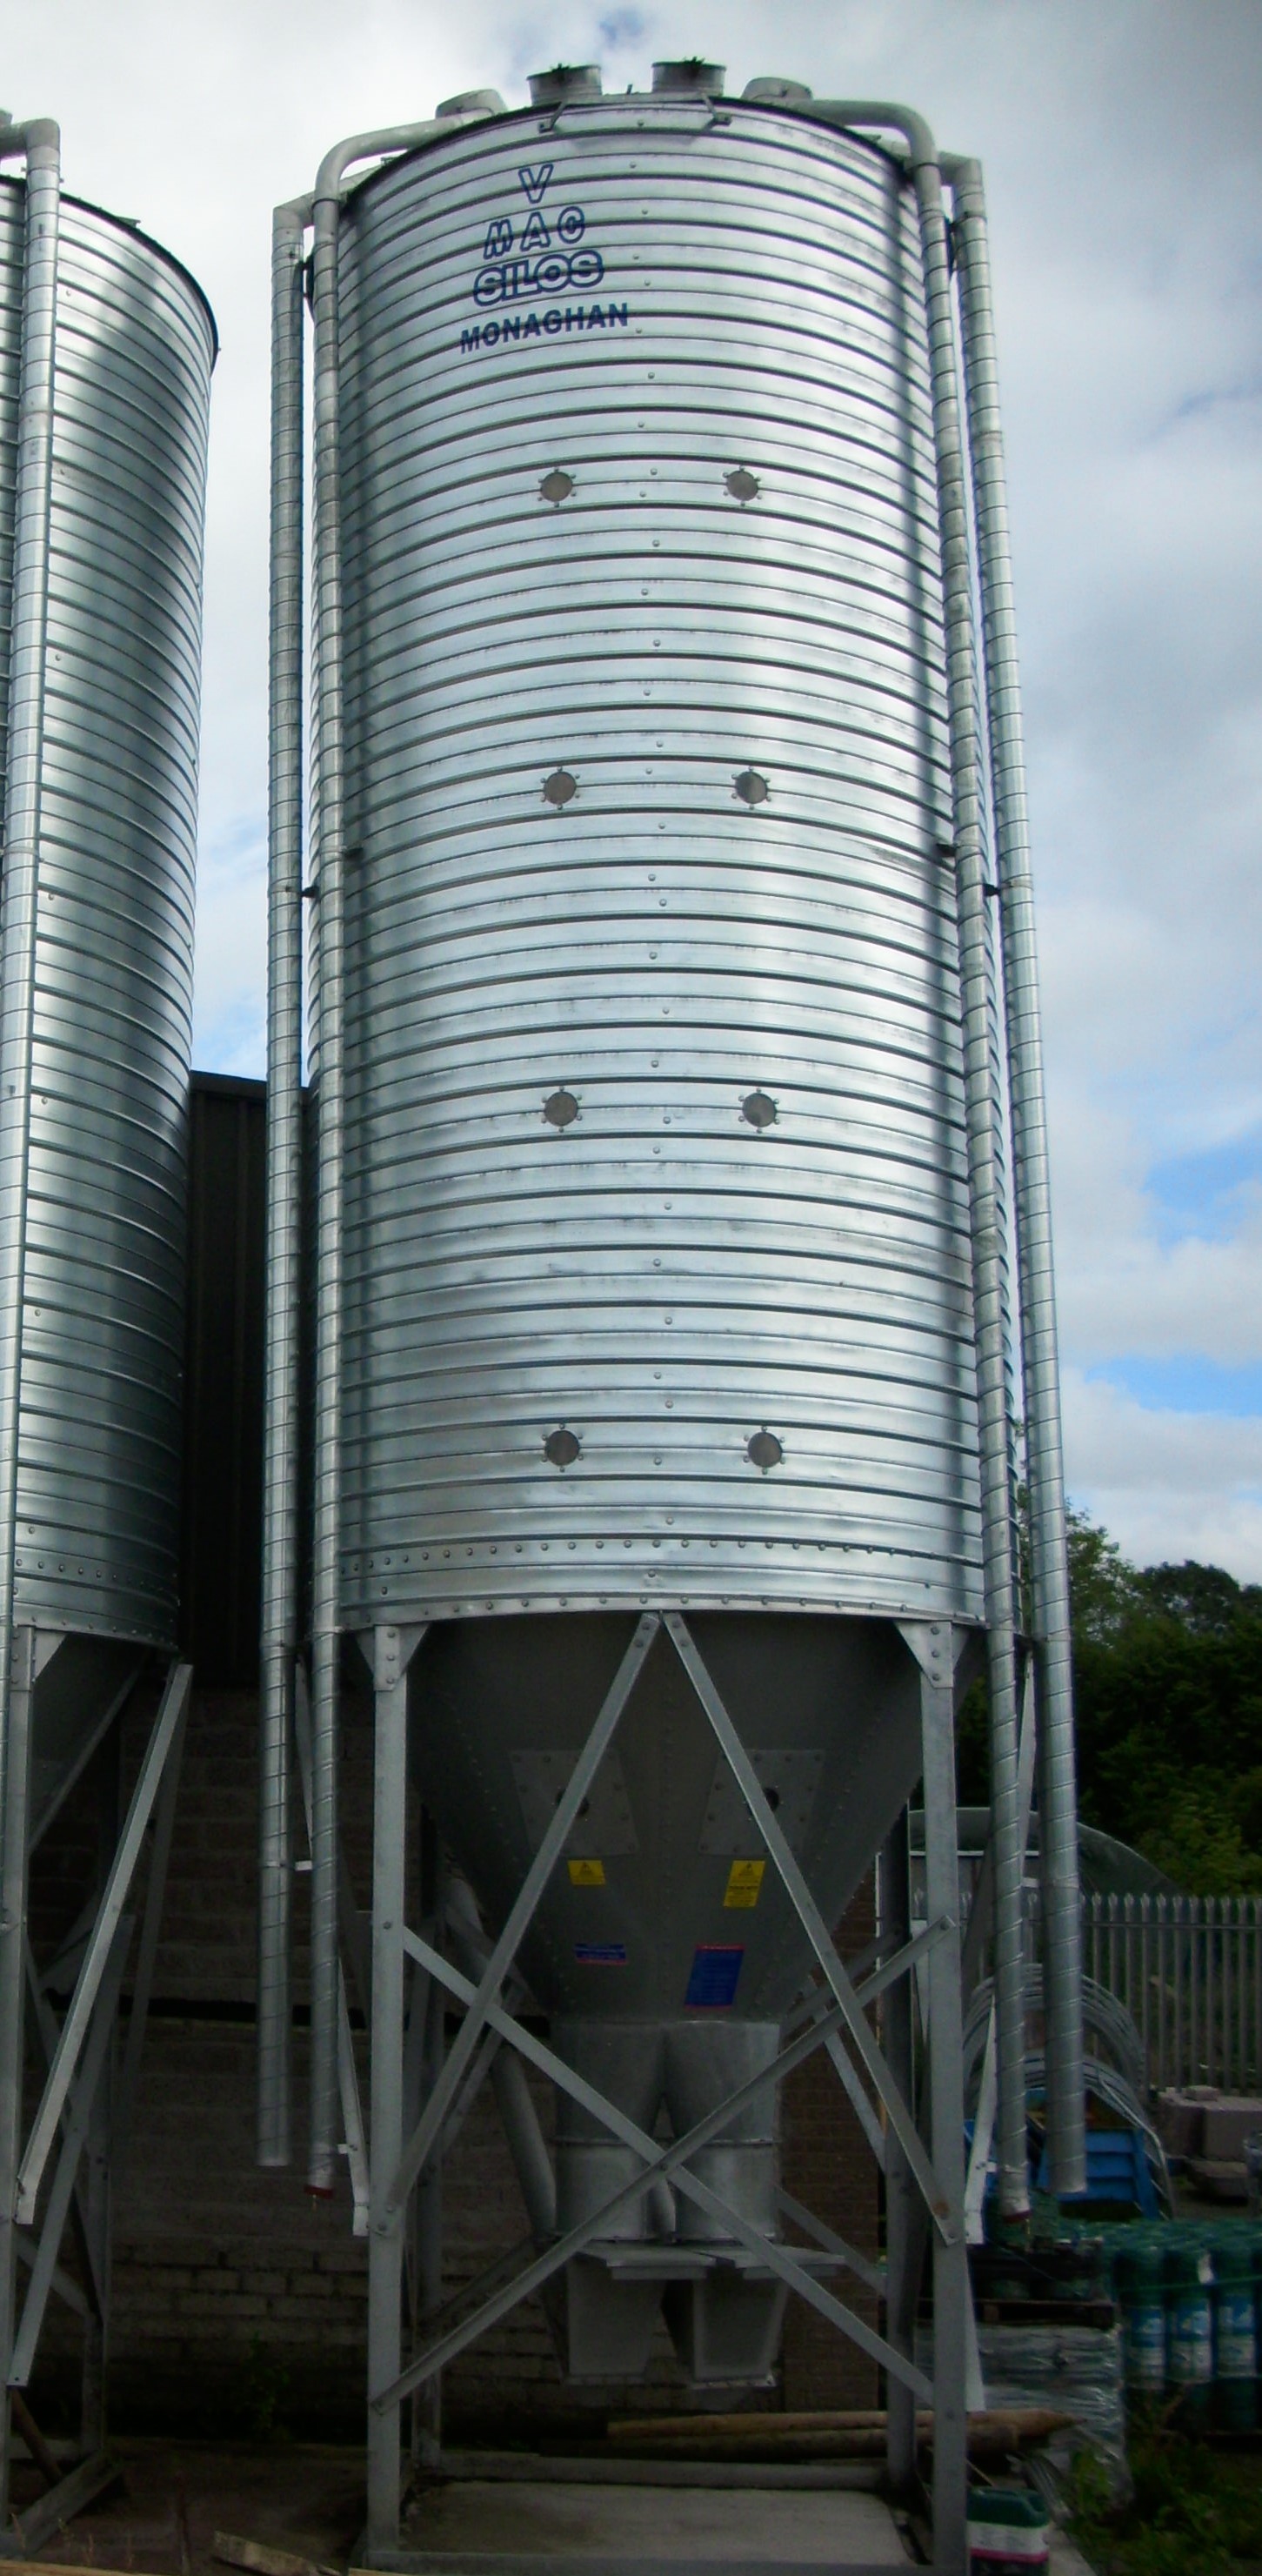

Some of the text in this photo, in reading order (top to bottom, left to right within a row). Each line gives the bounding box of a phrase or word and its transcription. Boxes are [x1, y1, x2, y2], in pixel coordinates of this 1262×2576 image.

[518, 164, 554, 204] V
[484, 206, 585, 259] MAC
[474, 250, 604, 306] SILOS
[460, 303, 628, 353] MONAGHAN
